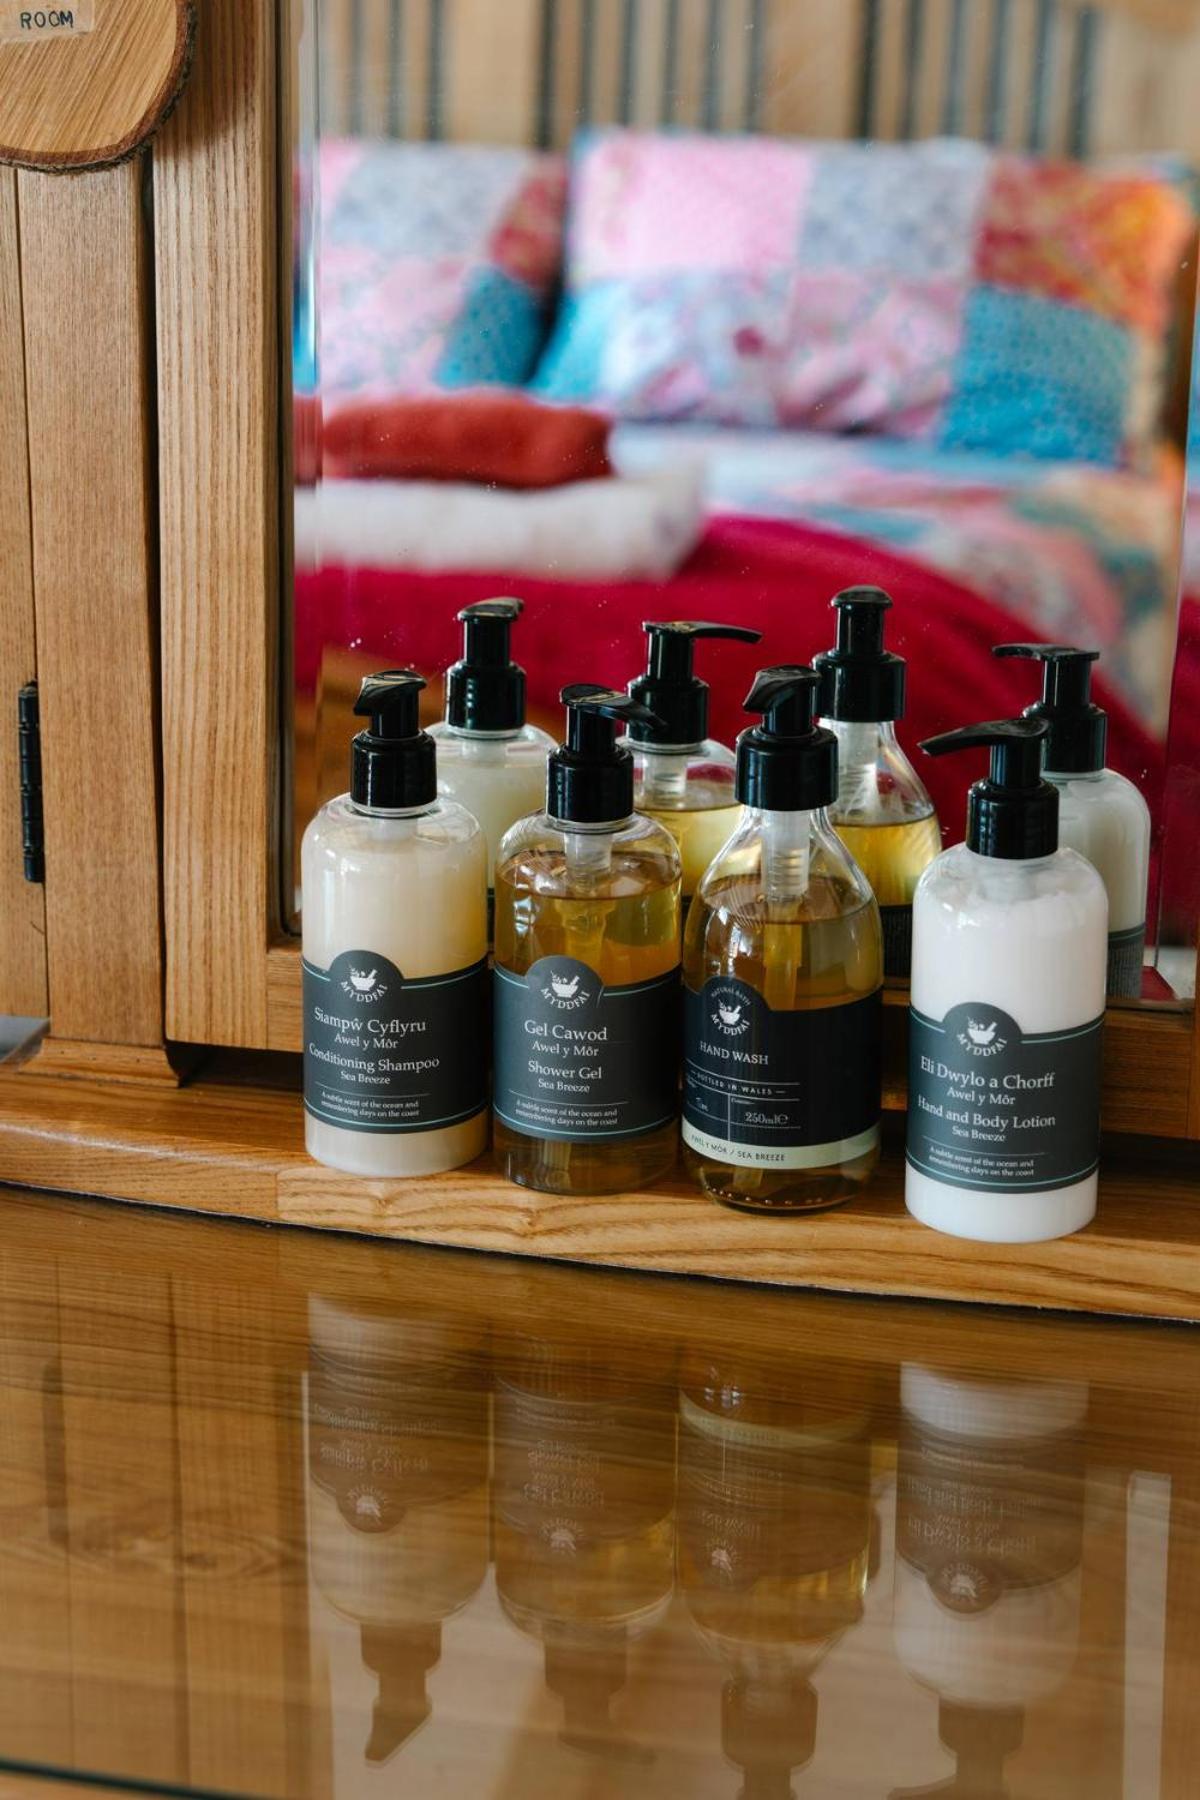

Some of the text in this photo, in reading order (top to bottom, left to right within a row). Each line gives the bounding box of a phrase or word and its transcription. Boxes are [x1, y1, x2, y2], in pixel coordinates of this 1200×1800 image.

[20, 11, 74, 30] ROOM
[340, 980, 388, 1003] MYDDFAI
[541, 987, 590, 1010] MYDDFAI
[367, 1019, 426, 1037] Cyflyru
[524, 1019, 608, 1041] Gel Cawod
[334, 1033, 398, 1051] Awel y Môr
[532, 1040, 599, 1058] Awel y Môr
[956, 1033, 1008, 1057] MYDDFAI
[309, 1042, 440, 1074] Conditioning Shampoo
[700, 1040, 769, 1065] HAND WASH
[340, 1070, 391, 1084] Sea Breeze
[528, 1060, 602, 1079] Shower Gel
[921, 1055, 1055, 1089] Eli Dwylo a Chorff
[538, 1078, 590, 1093] Sea Breeze
[741, 1086, 773, 1095] WALES
[946, 1087, 1016, 1106] Awel y Môr
[388, 1109, 400, 1117] the
[918, 1094, 1056, 1132] Hand and Body Lotion
[952, 1125, 1006, 1142] Sea Breeze
[737, 1150, 753, 1160] SEA
[755, 1153, 785, 1162] BREEZE
